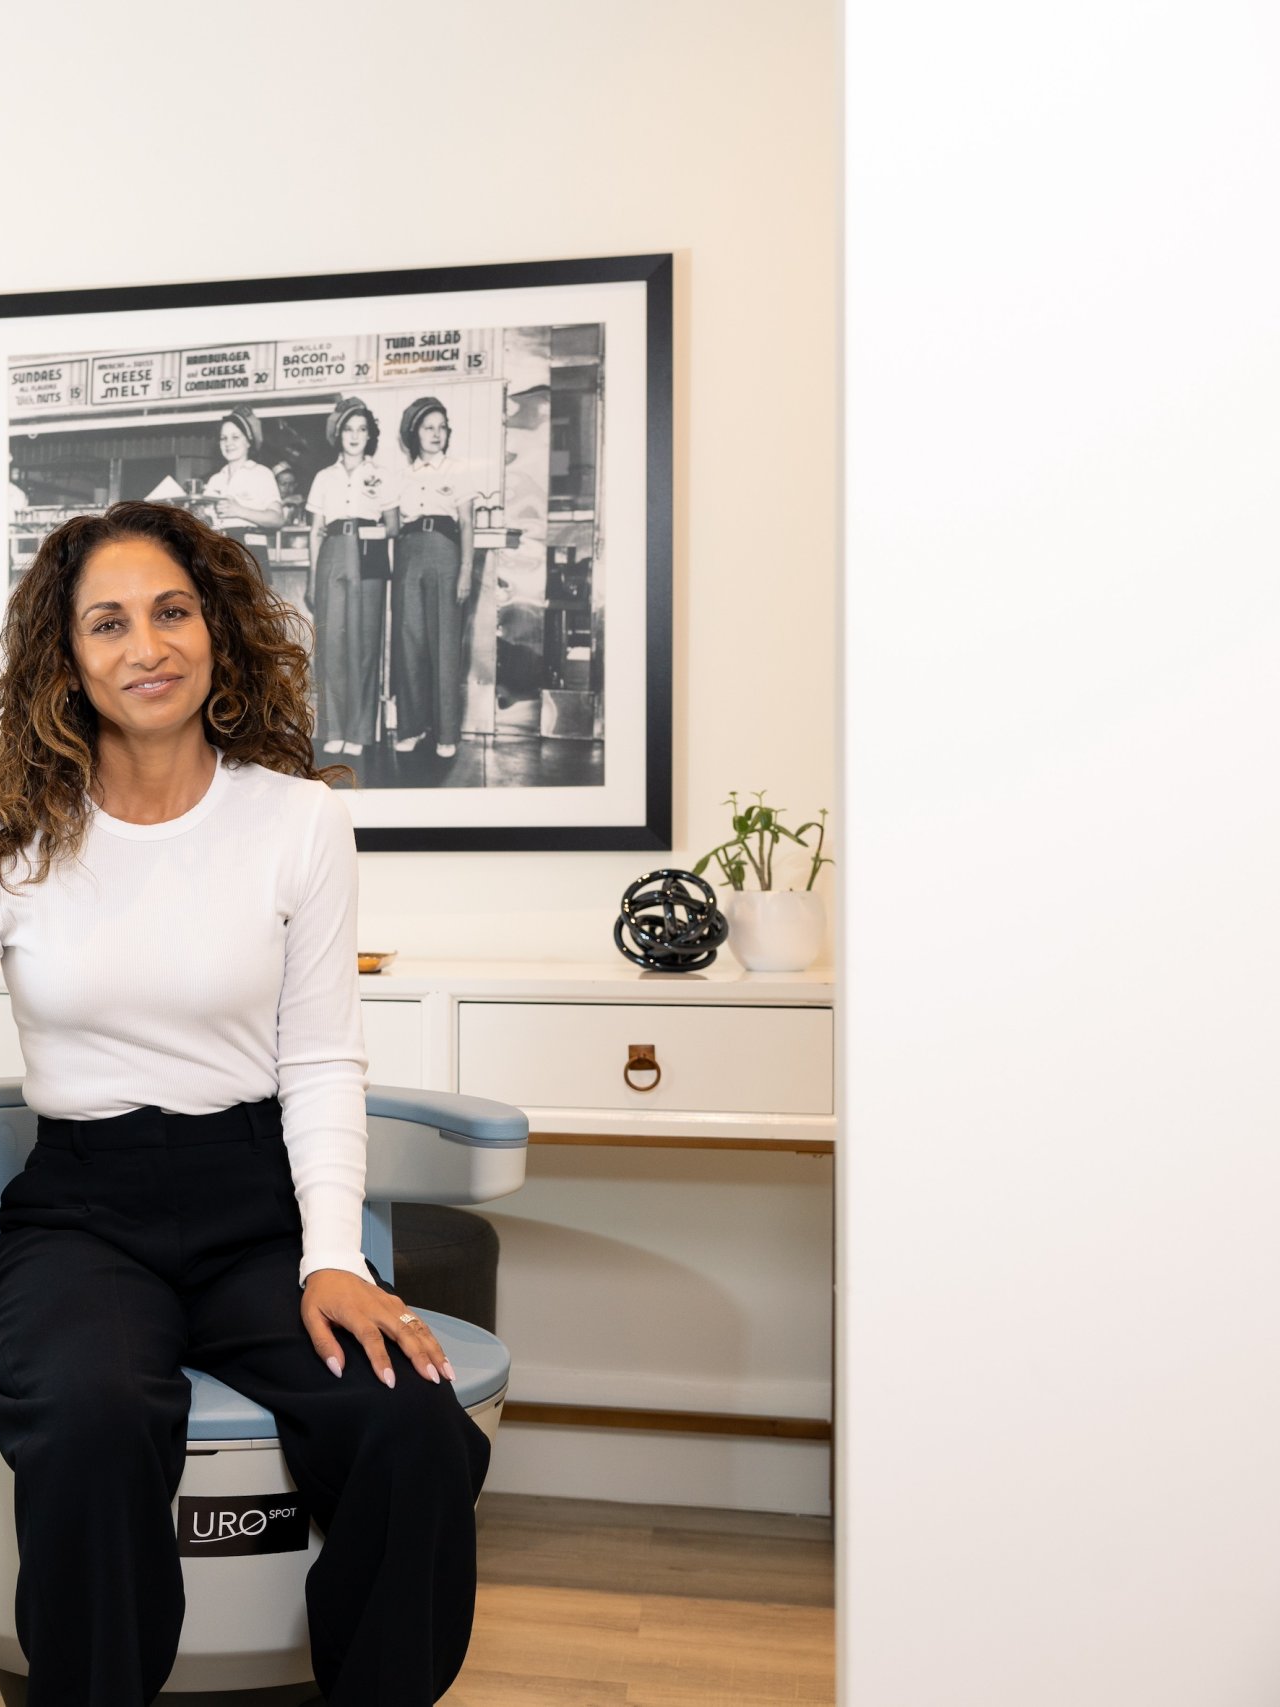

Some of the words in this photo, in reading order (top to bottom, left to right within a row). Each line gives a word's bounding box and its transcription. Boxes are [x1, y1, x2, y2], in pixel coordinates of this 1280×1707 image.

[384, 336, 415, 350] TUNA
[419, 330, 461, 347] SALAD
[186, 351, 250, 365] HAMBURGER
[283, 352, 328, 366] BACON
[383, 348, 460, 366] SANDWICH
[12, 368, 62, 384] SUNDAES
[102, 369, 152, 384] CHEESE
[201, 364, 246, 376] CHEESE
[283, 363, 345, 378] TOMATO
[100, 384, 150, 399] MELT
[185, 377, 249, 391] COMBINATION
[36, 392, 61, 404] NUTS
[191, 1509, 267, 1541] URO
[269, 1507, 297, 1519] SPOT
